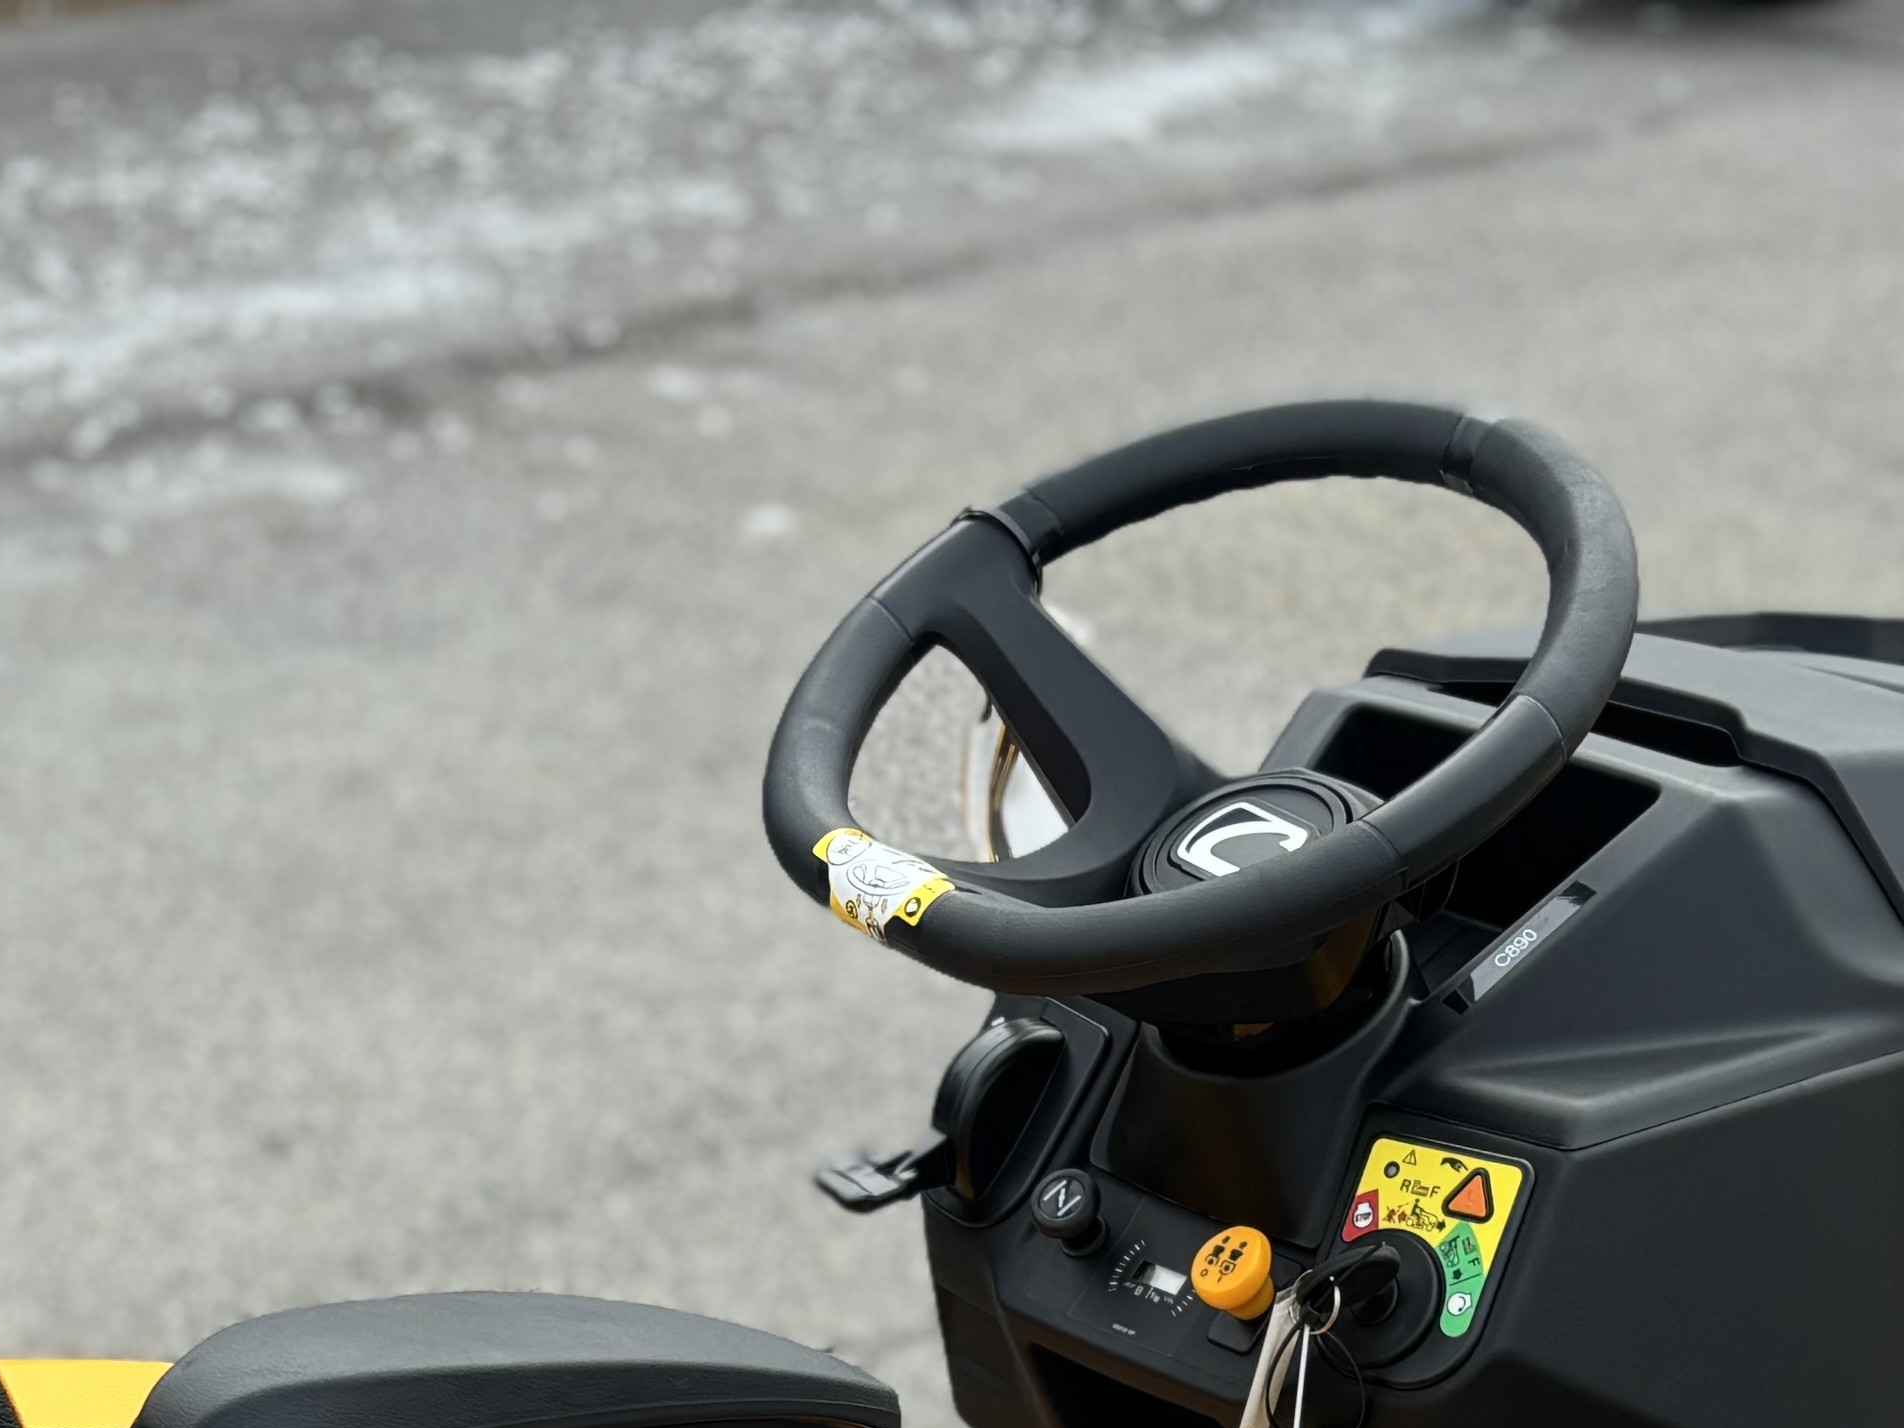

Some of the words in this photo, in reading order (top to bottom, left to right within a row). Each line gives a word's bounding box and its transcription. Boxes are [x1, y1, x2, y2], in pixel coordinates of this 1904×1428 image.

[1494, 928, 1538, 968] C890
[1399, 1178, 1412, 1193] R
[1428, 1185, 1441, 1198] F
